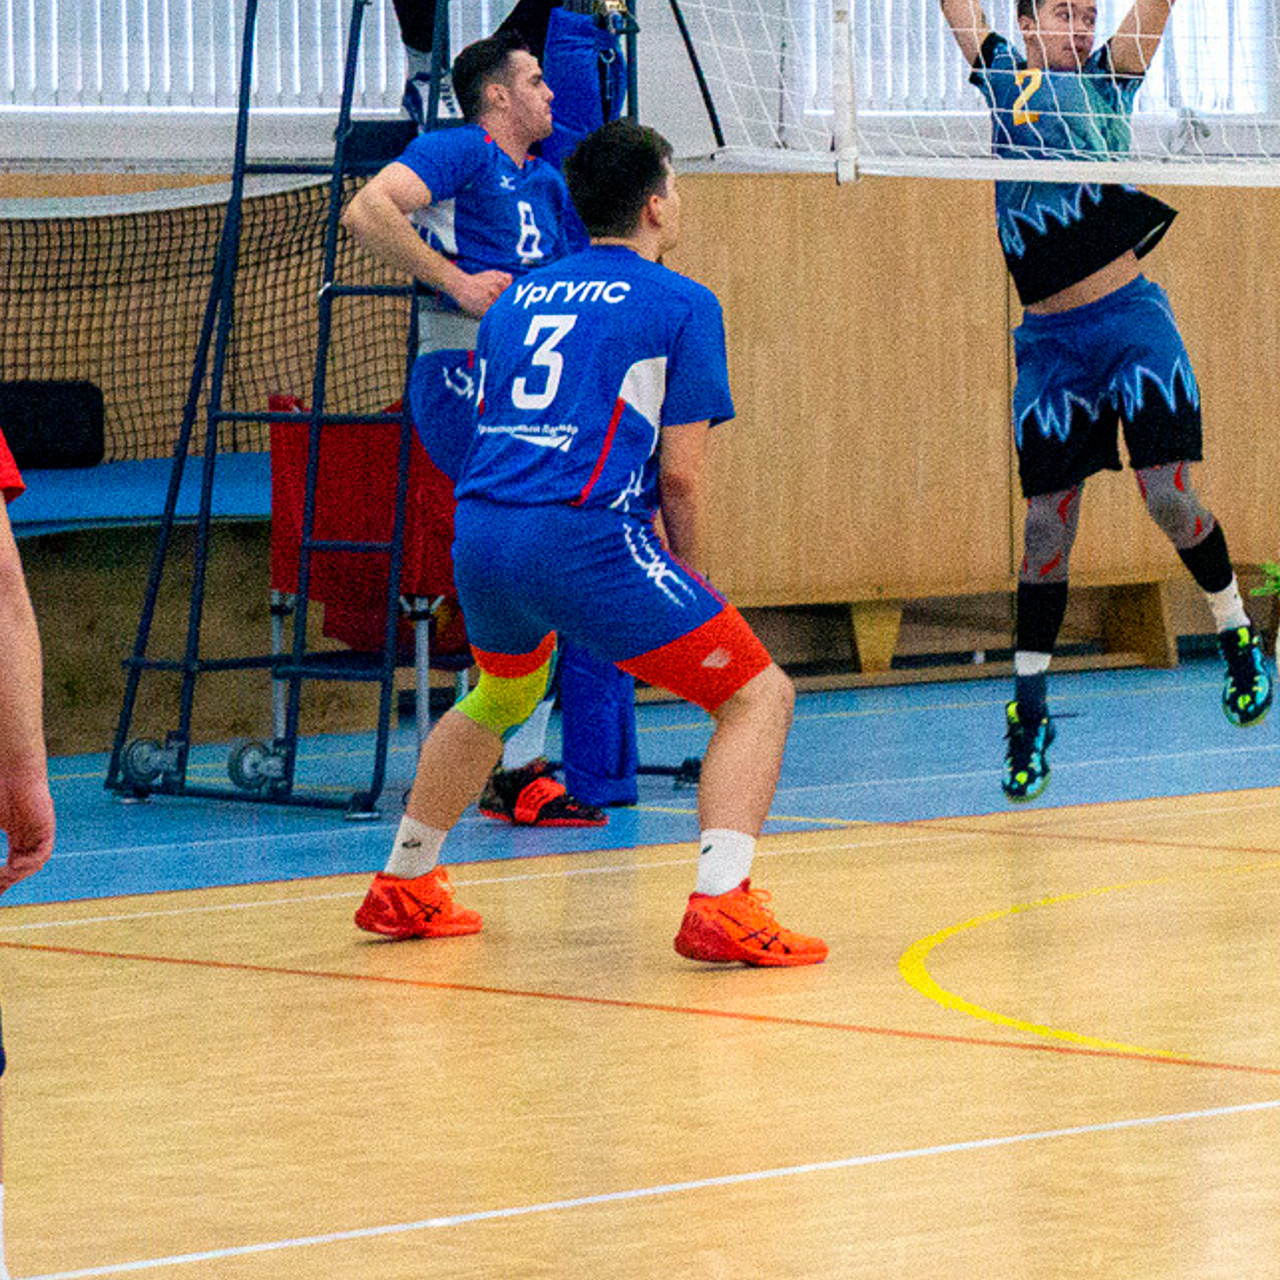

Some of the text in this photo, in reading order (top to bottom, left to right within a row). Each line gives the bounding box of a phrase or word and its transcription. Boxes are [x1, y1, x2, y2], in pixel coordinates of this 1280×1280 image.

[1012, 67, 1042, 126] 2
[516, 200, 544, 260] 8
[513, 280, 631, 309] УрГУПС
[511, 314, 578, 410] 3
